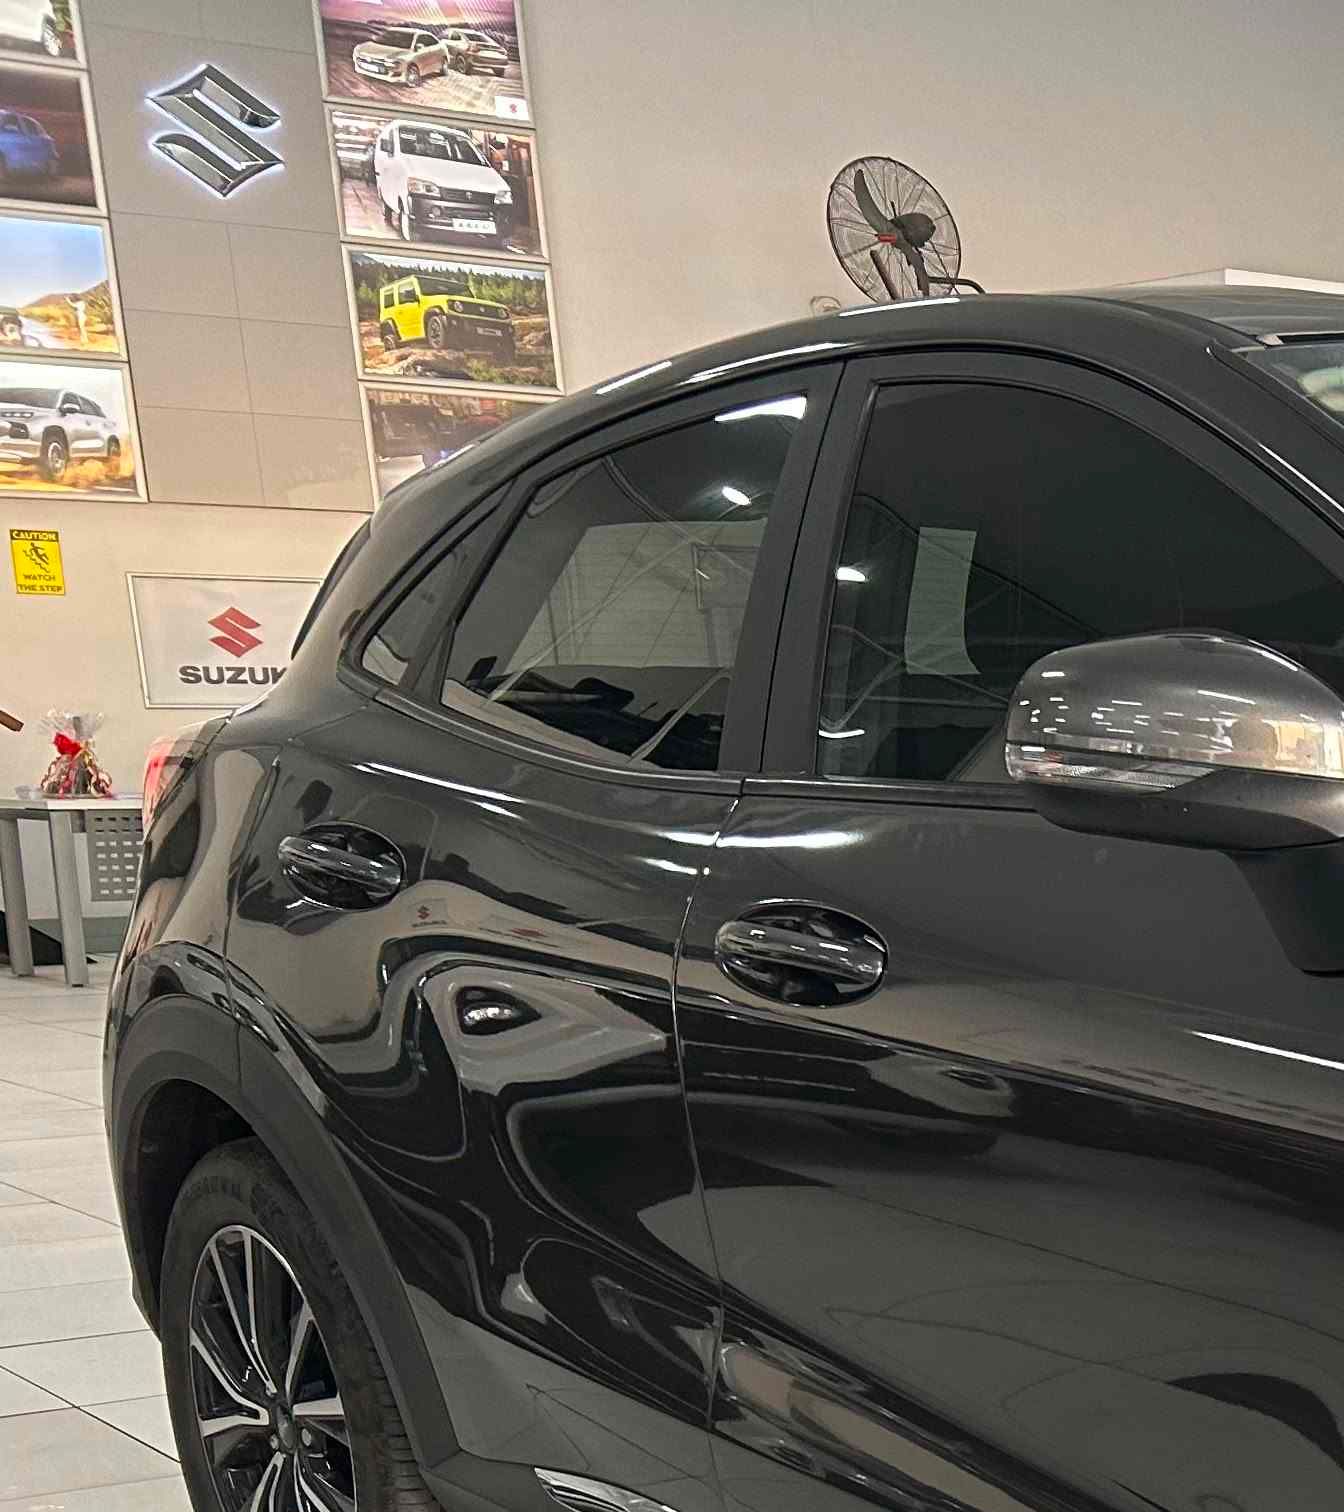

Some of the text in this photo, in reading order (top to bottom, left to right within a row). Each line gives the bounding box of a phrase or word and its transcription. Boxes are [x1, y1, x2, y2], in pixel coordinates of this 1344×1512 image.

[12, 531, 57, 541] CAUTION
[23, 574, 56, 582] WATCH
[17, 583, 38, 592] THE
[178, 665, 287, 685] SUZUK
